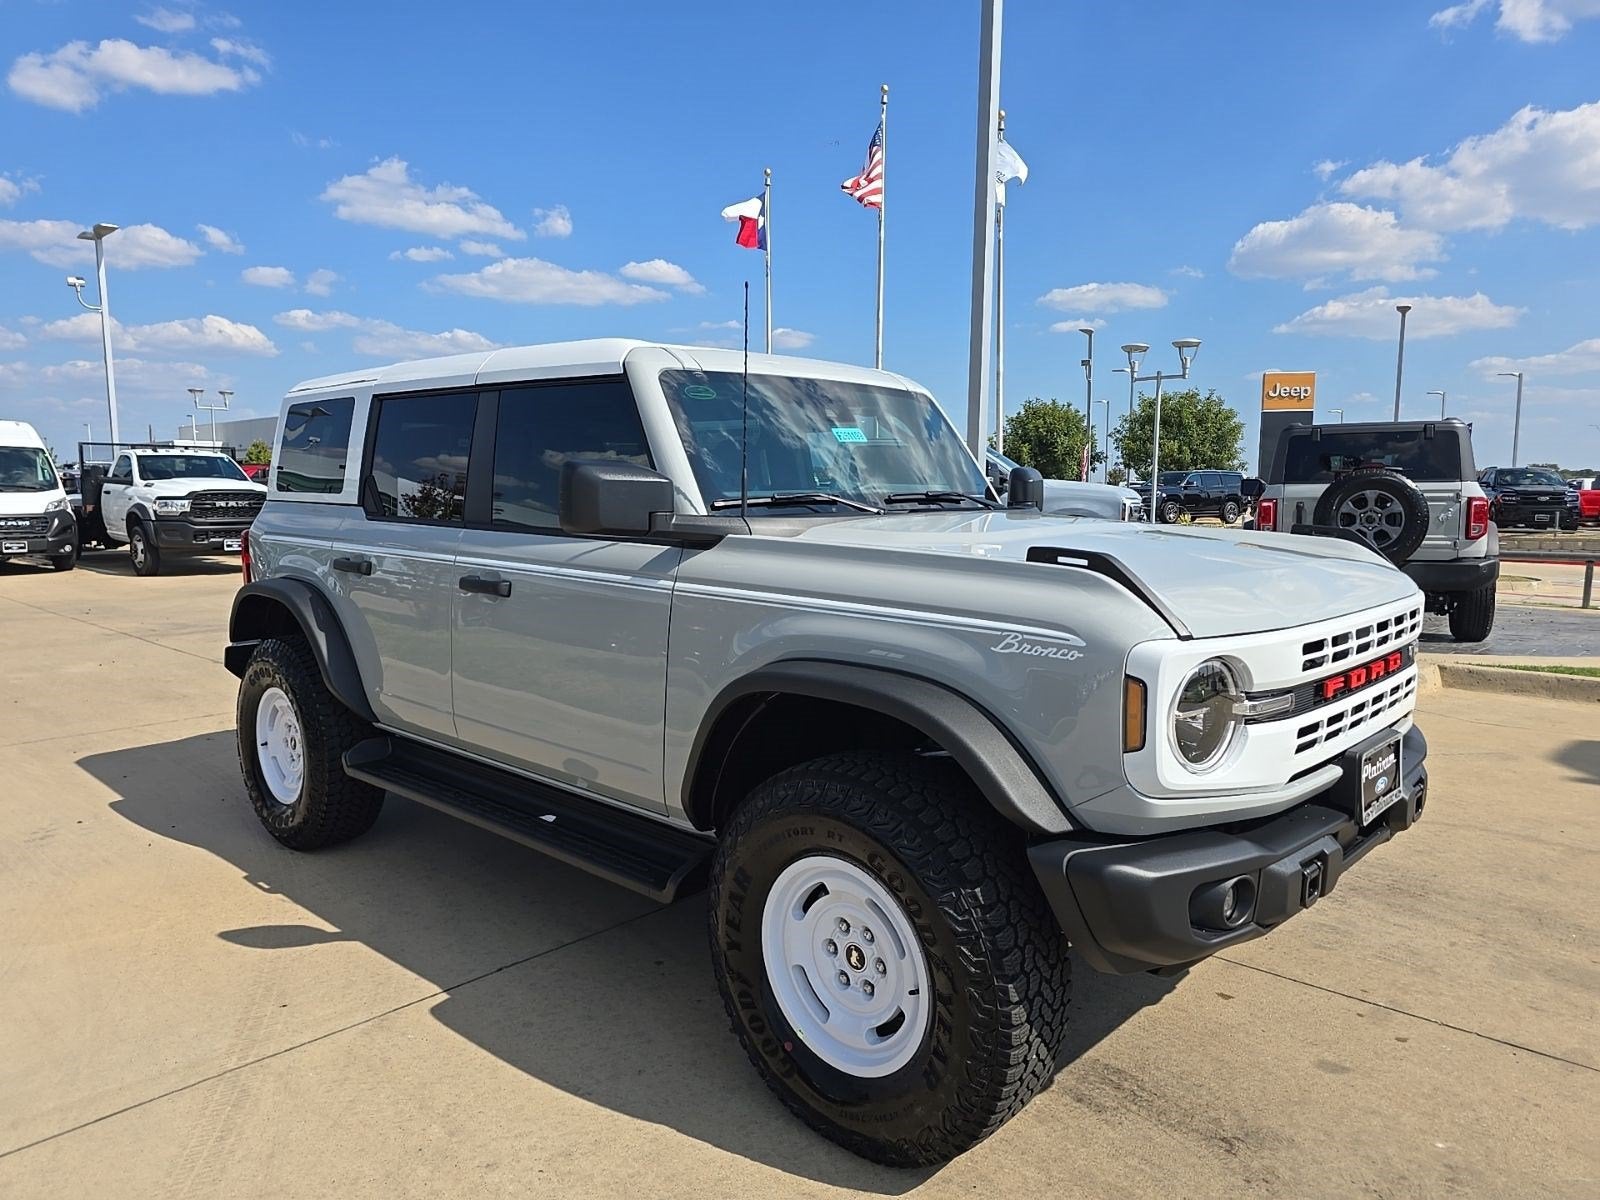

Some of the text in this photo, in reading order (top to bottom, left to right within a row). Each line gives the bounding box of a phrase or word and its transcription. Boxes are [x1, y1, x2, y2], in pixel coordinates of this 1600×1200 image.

[1268, 383, 1311, 399] Jeep
[990, 632, 1084, 660] Bronco
[1323, 652, 1402, 699] FORD
[1361, 753, 1397, 783] Platinum
